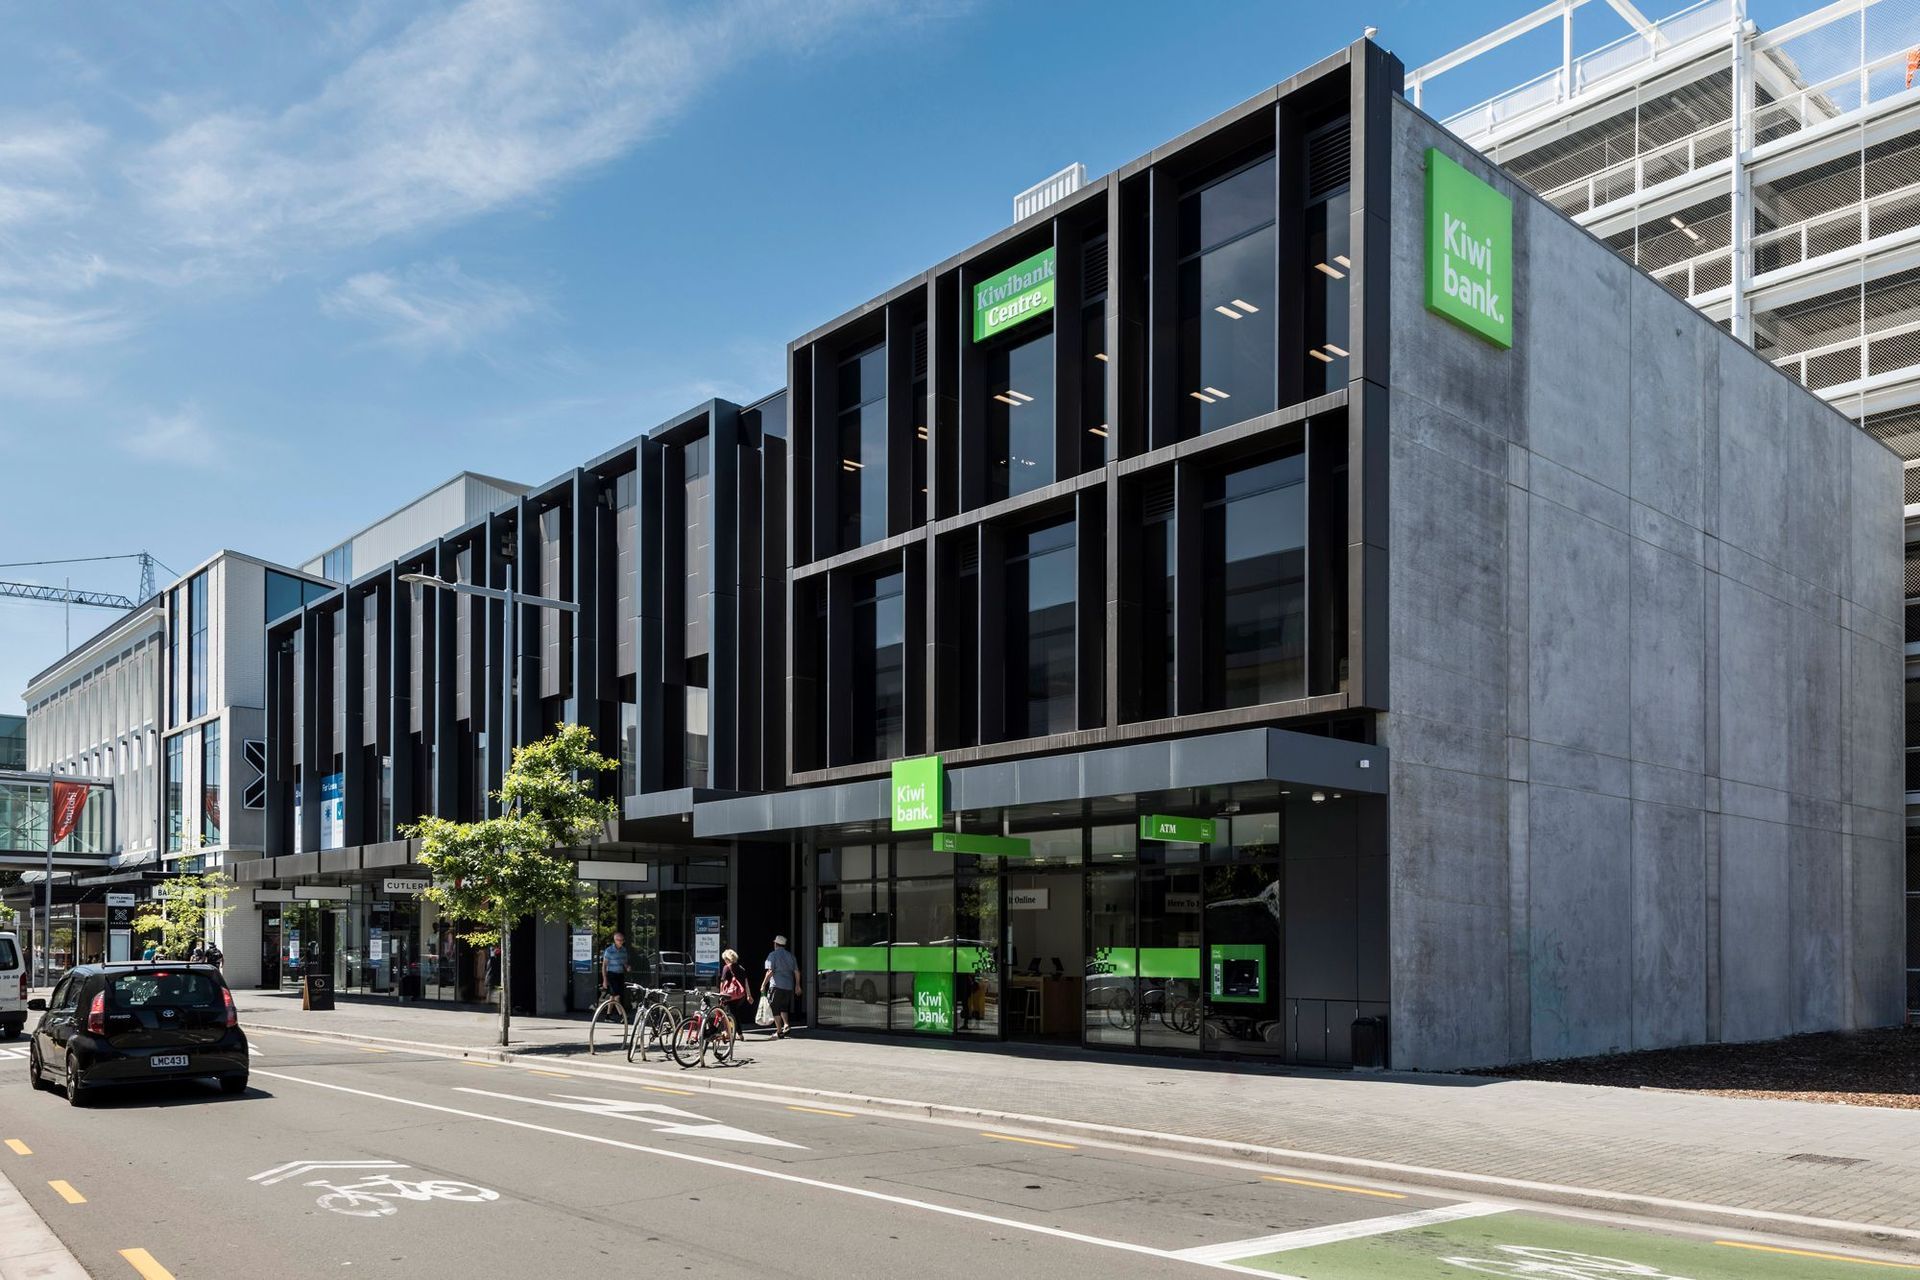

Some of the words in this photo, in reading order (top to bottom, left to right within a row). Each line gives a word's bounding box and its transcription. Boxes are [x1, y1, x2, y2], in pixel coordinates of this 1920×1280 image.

[1443, 211, 1492, 275] Kiwi
[977, 259, 1055, 311] Kiwibank
[1443, 253, 1505, 324] bank.
[988, 291, 1048, 327] Centre.
[897, 783, 925, 802] Kiwi
[896, 802, 933, 822] bank.
[1160, 823, 1176, 834] ATM
[1014, 895, 1036, 904] Online
[918, 991, 942, 1007] Kiwi
[918, 1007, 949, 1024] bank.
[151, 1056, 187, 1067] LMC431
